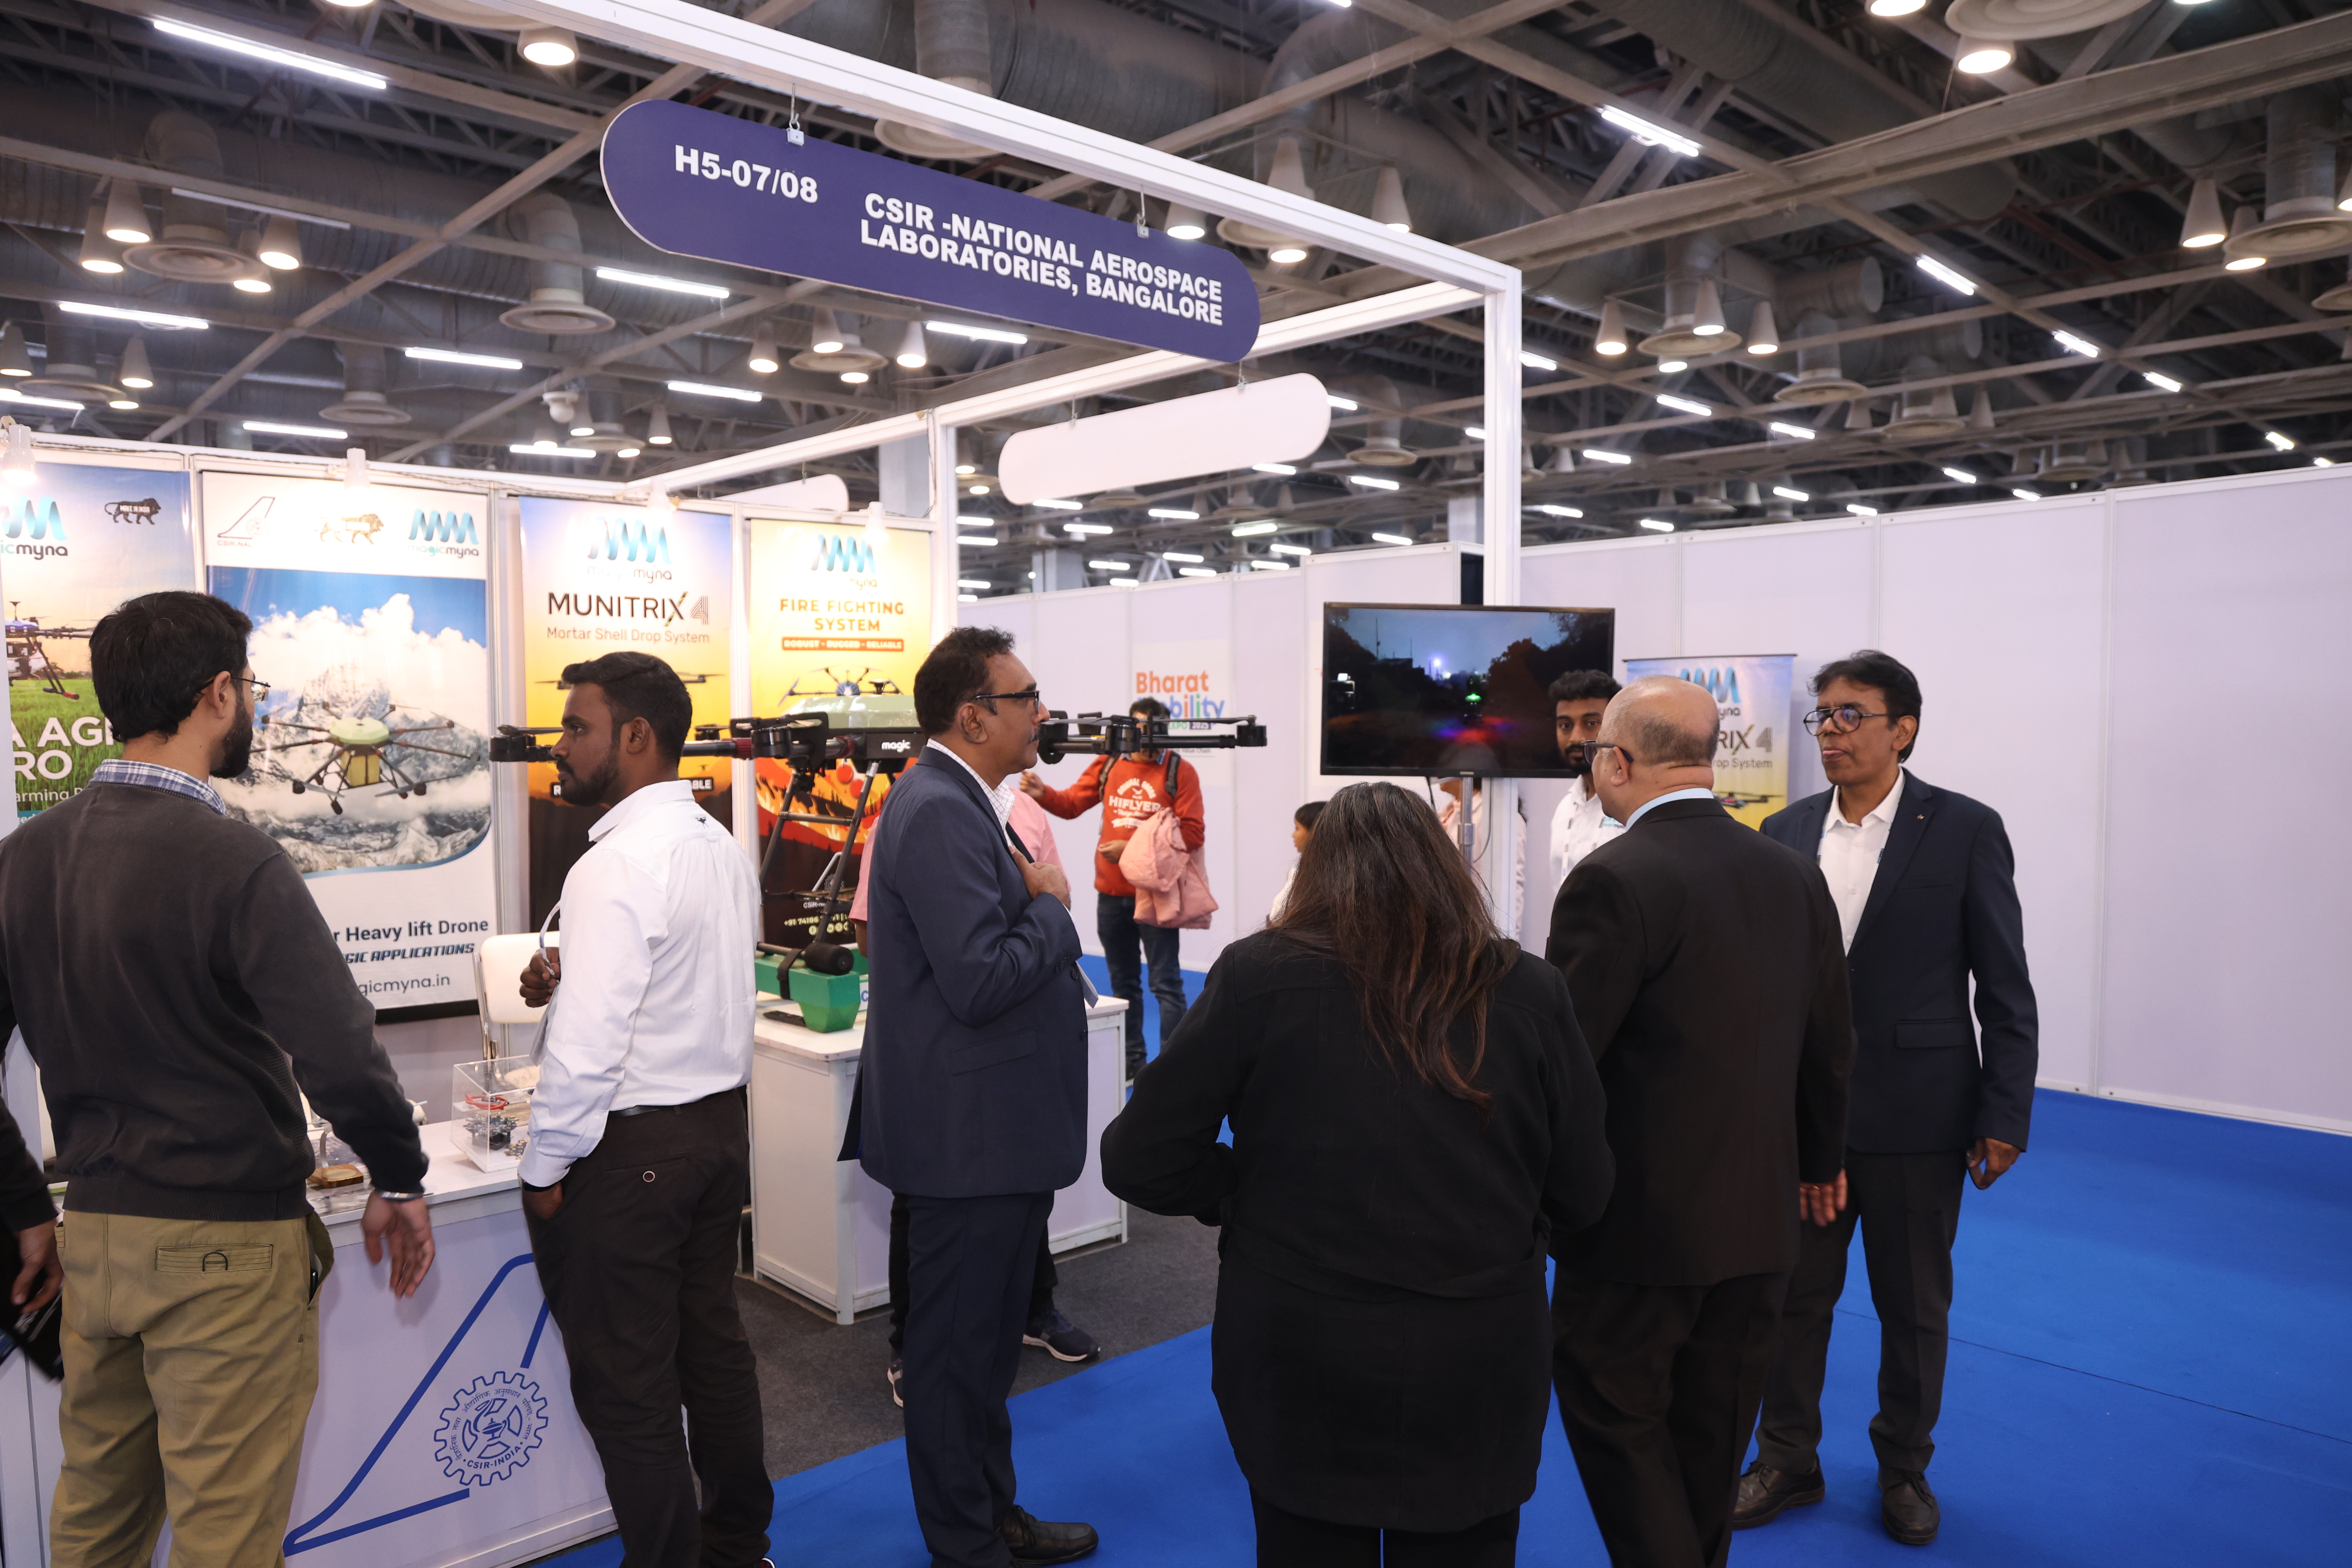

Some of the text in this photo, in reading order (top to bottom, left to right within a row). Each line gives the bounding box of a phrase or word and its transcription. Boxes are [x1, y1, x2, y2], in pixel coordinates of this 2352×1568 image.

[675, 144, 818, 203] H5-07/08
[865, 192, 935, 232] CSIR
[1090, 249, 1222, 302] AEROSPACE
[861, 219, 1223, 326] LABORATORIES, BANGALORE
[408, 543, 479, 559] magicmyna
[548, 591, 709, 627] MUNITRIX 4
[780, 598, 904, 615] FIRE FIGHTING
[815, 618, 880, 632] SYSTEM
[547, 626, 709, 644] Mortar Shell Drop System
[784, 640, 902, 649] ROBUST RUGGED RELIABLE
[1136, 670, 1209, 693] Bharat
[1160, 694, 1225, 724] bility
[881, 739, 911, 753] magic
[1733, 758, 1773, 769] System
[1109, 795, 1161, 812] HIFLYER
[346, 926, 402, 942] Heavy
[408, 922, 432, 936] lift
[439, 920, 489, 934] Drone
[370, 943, 475, 962] APPLICATIONS
[467, 1446, 521, 1469] CSIR-INDIA
